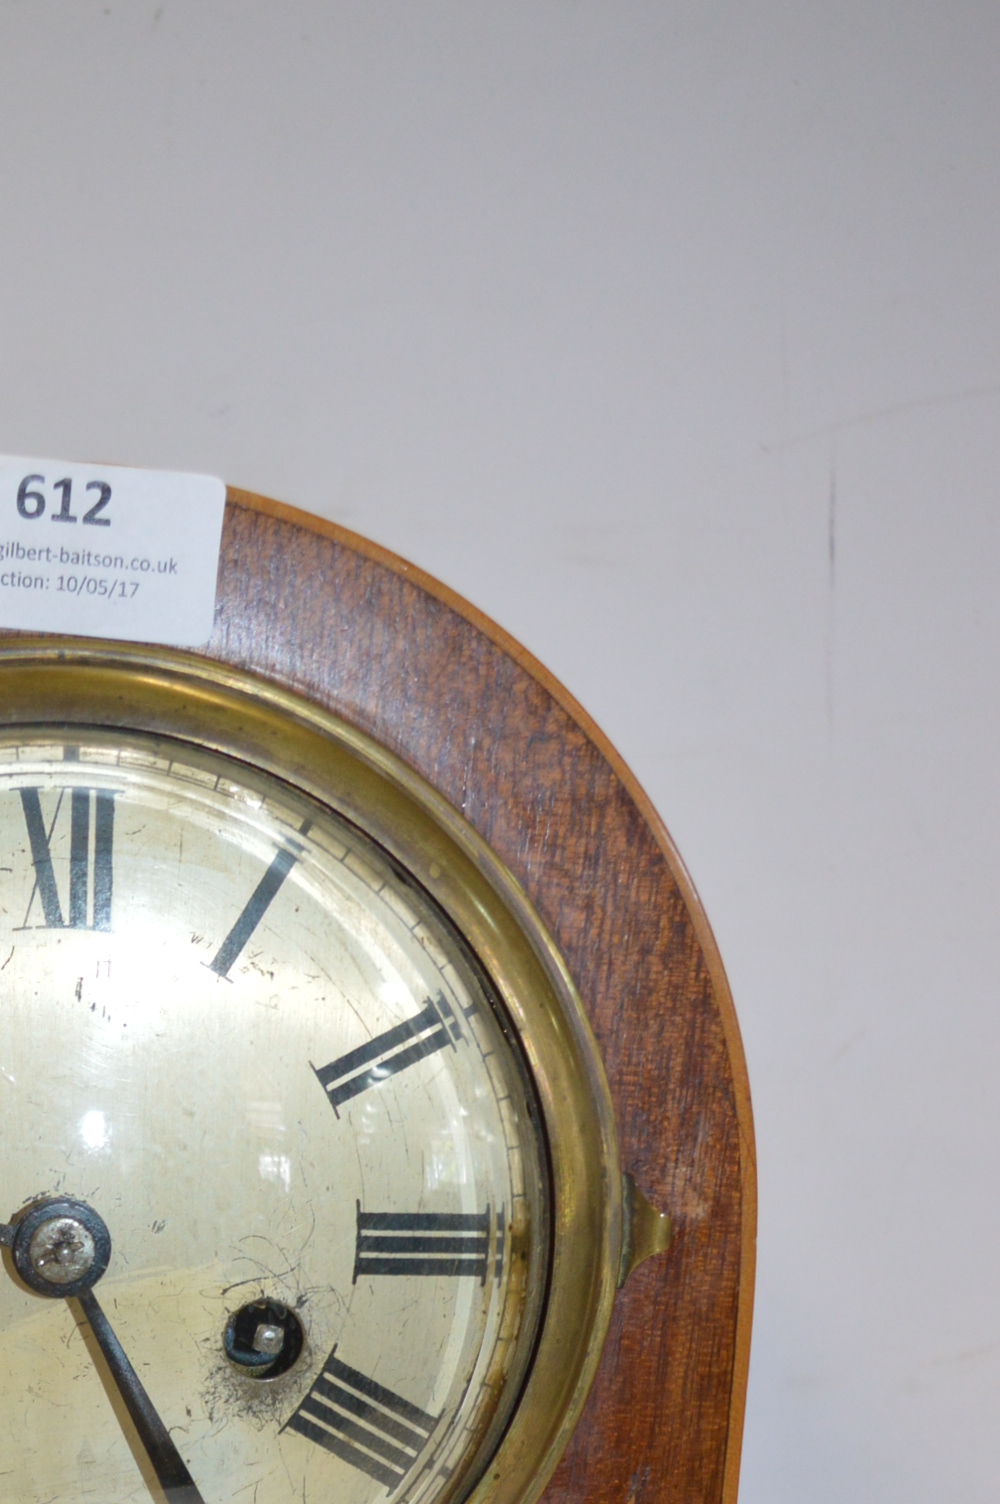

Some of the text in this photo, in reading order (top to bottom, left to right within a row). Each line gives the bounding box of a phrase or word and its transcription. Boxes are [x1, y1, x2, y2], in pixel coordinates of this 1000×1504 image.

[16, 473, 113, 527] 612
[55, 574, 140, 599] 10/05/17
[9, 785, 126, 933] XII
[201, 833, 312, 984] I
[308, 988, 472, 1120] II
[352, 1199, 505, 1288] III
[277, 1342, 446, 1497] IIII
